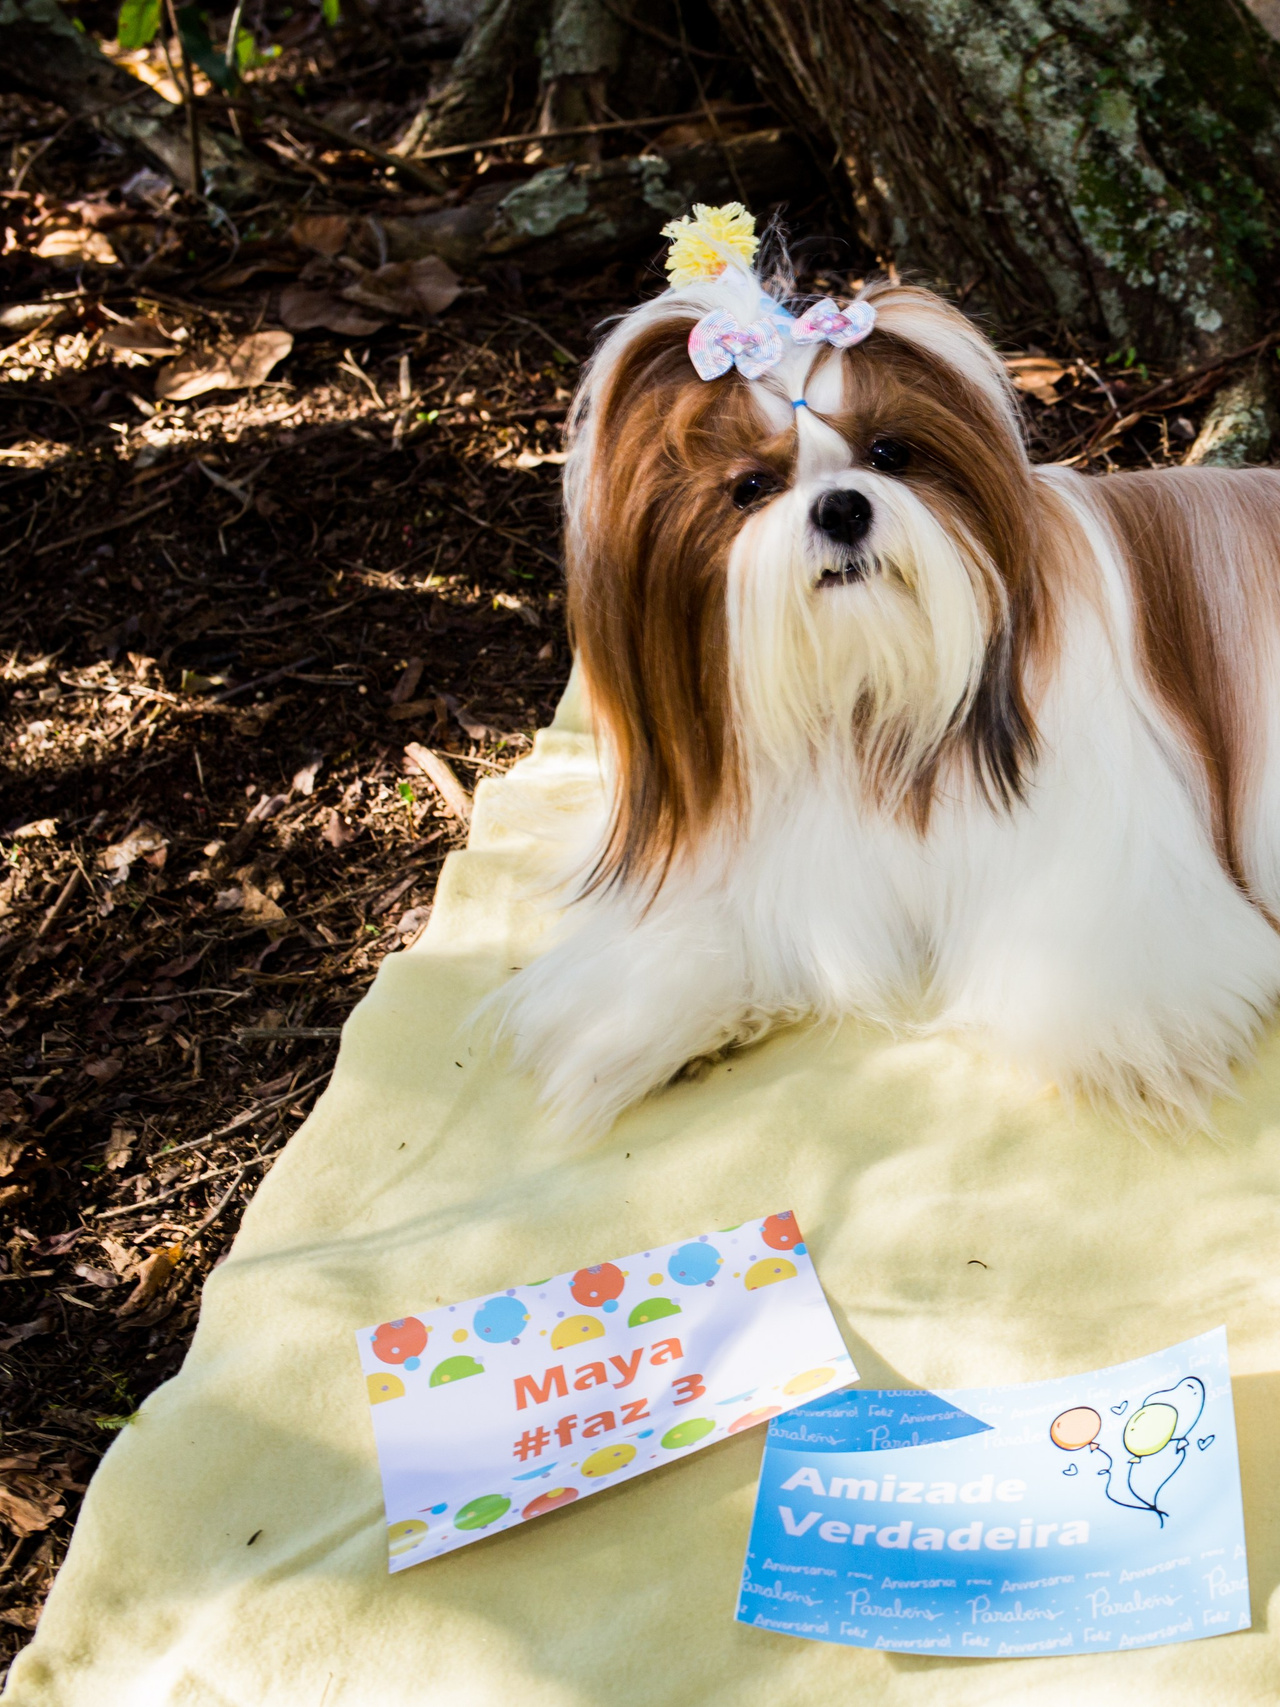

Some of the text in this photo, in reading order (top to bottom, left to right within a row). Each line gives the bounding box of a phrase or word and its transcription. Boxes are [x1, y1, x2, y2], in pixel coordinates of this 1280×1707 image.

[513, 1337, 685, 1411] Maya
[512, 1373, 707, 1463] #faz 3
[780, 1466, 1027, 1505] Amizade
[778, 1505, 1090, 1551] Verdadeira
